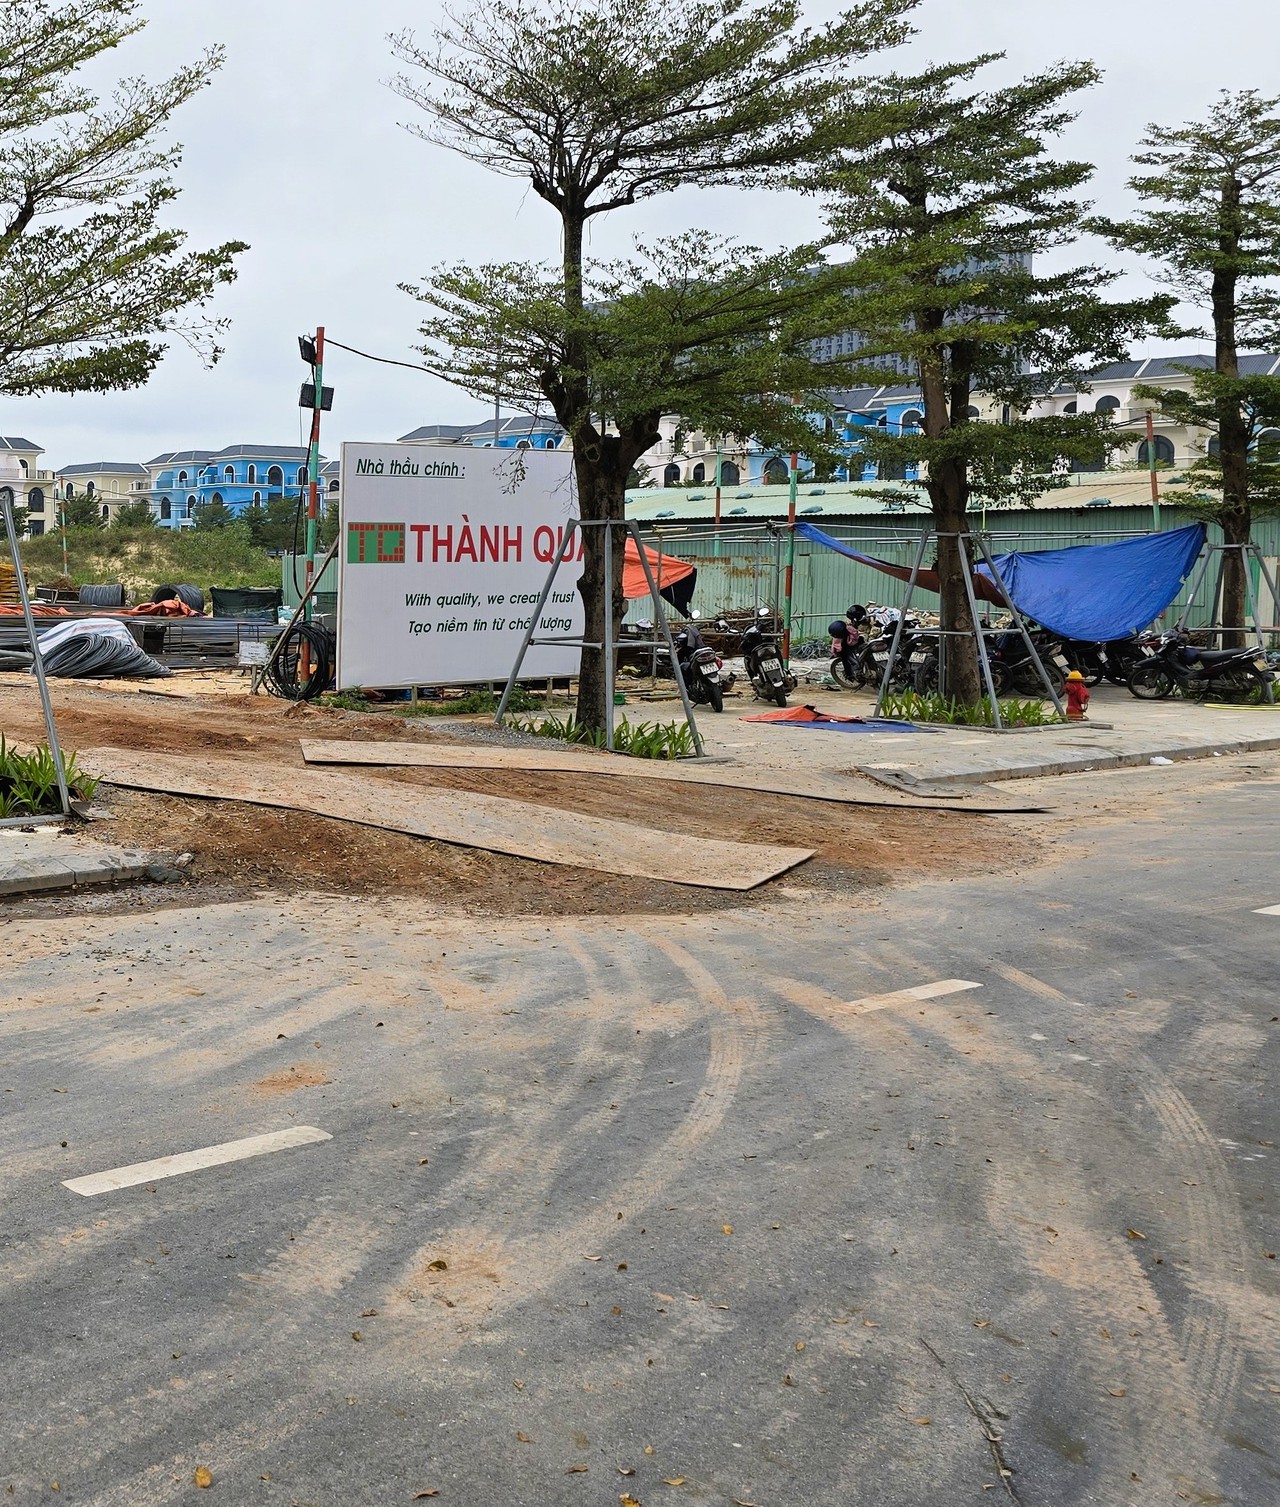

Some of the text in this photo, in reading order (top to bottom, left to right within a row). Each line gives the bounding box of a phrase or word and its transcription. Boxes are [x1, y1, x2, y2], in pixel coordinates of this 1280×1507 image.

[356, 458, 384, 474] Nhà
[390, 456, 419, 475] thầu
[410, 514, 522, 562] THÀNH
[405, 591, 575, 608] With quality, we creat trust
[409, 617, 572, 636] Tạo niềm tin từ chấ lượng
